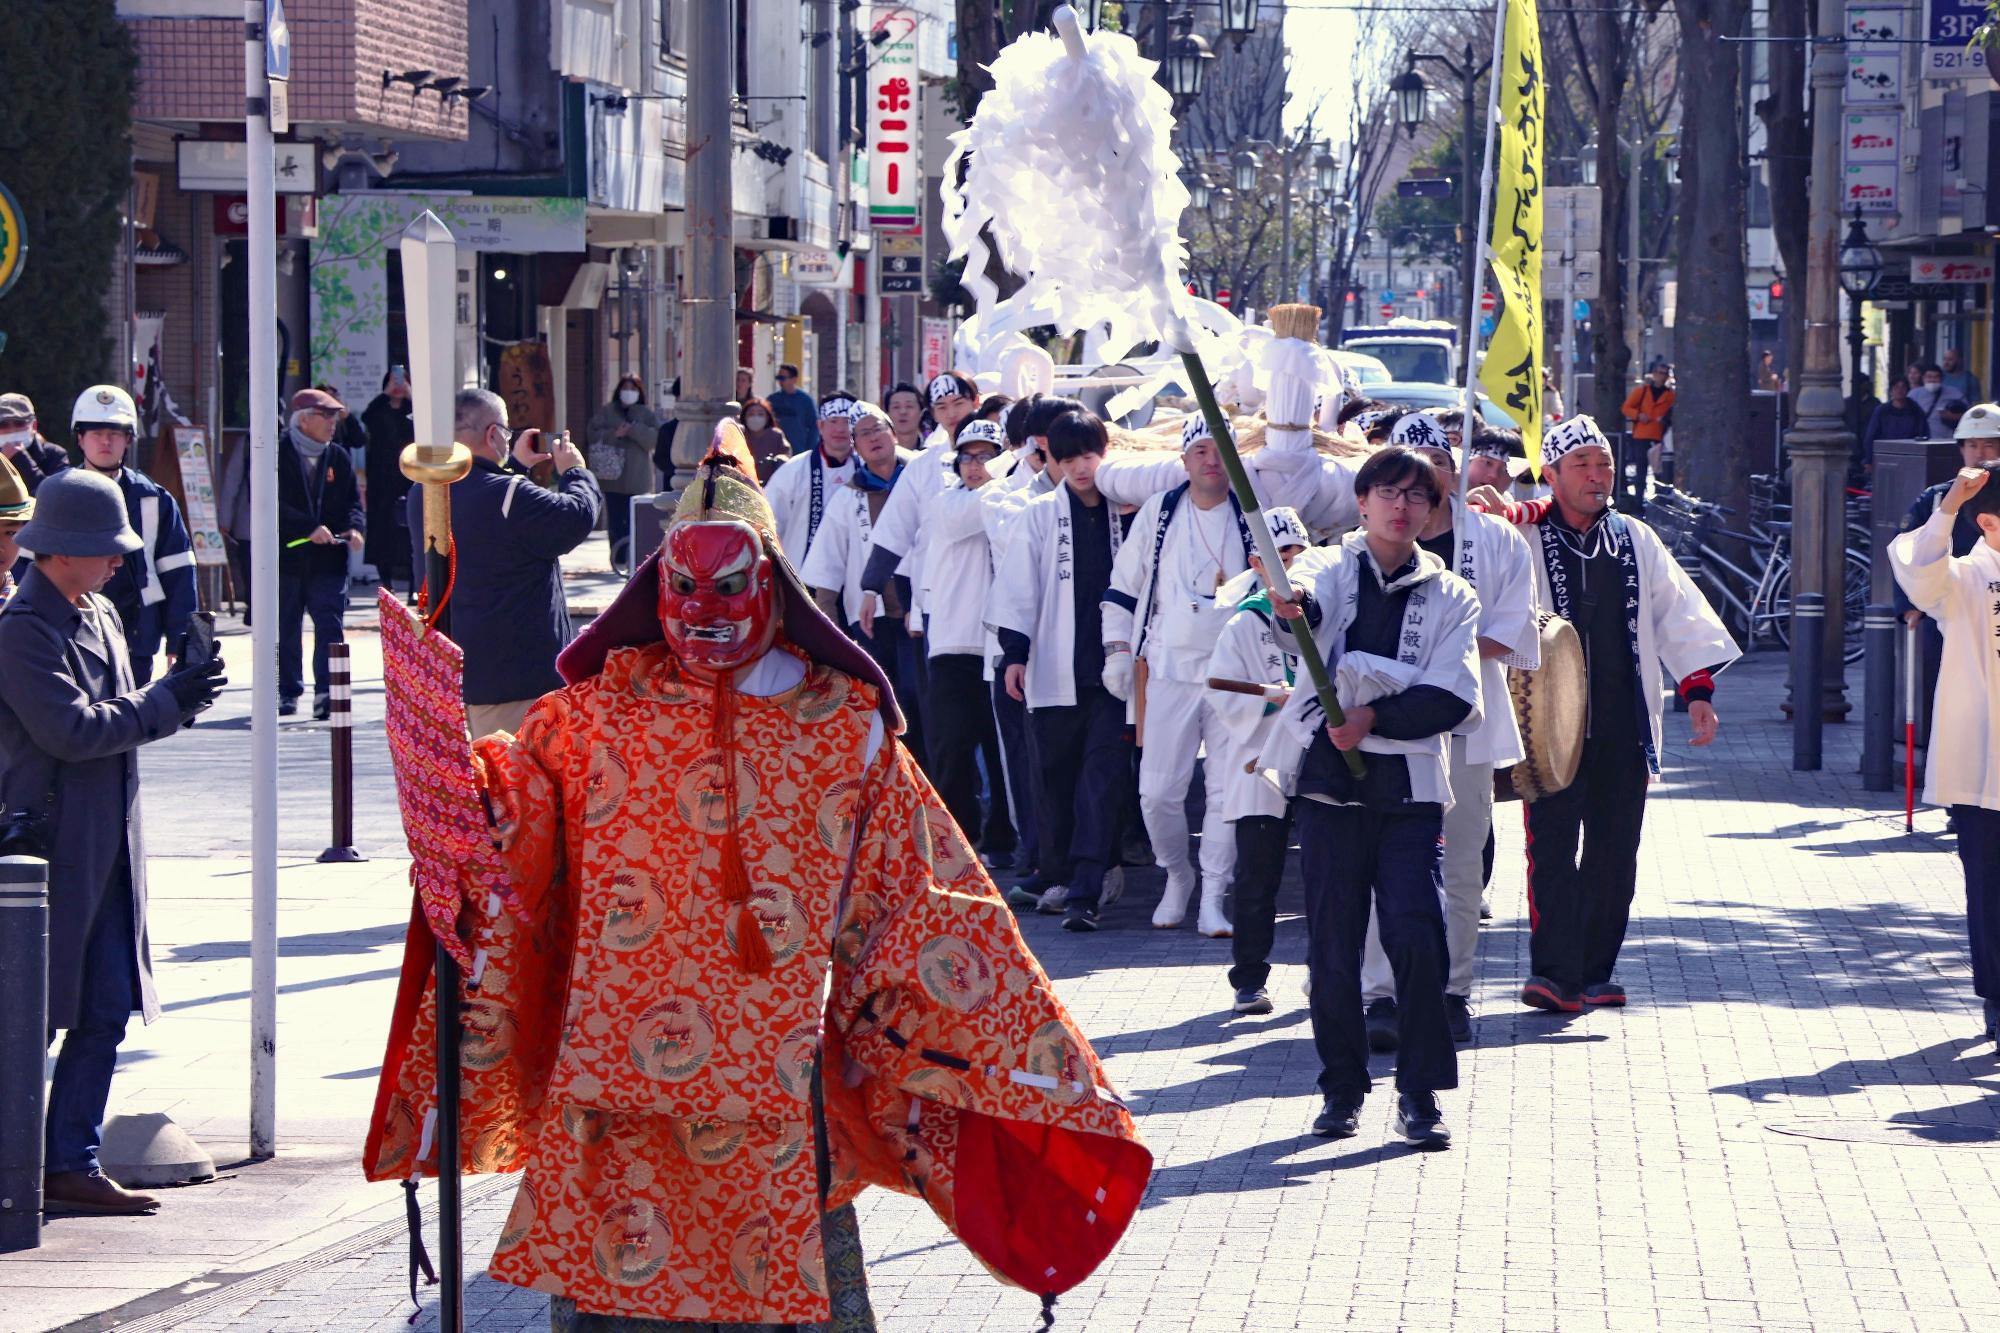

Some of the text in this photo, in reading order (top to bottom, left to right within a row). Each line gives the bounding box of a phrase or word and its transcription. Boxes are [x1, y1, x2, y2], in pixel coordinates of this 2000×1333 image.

[1939, 15, 1977, 37] 3F
[493, 204, 532, 213] FOREST
[1058, 516, 1071, 581] 信夫三山
